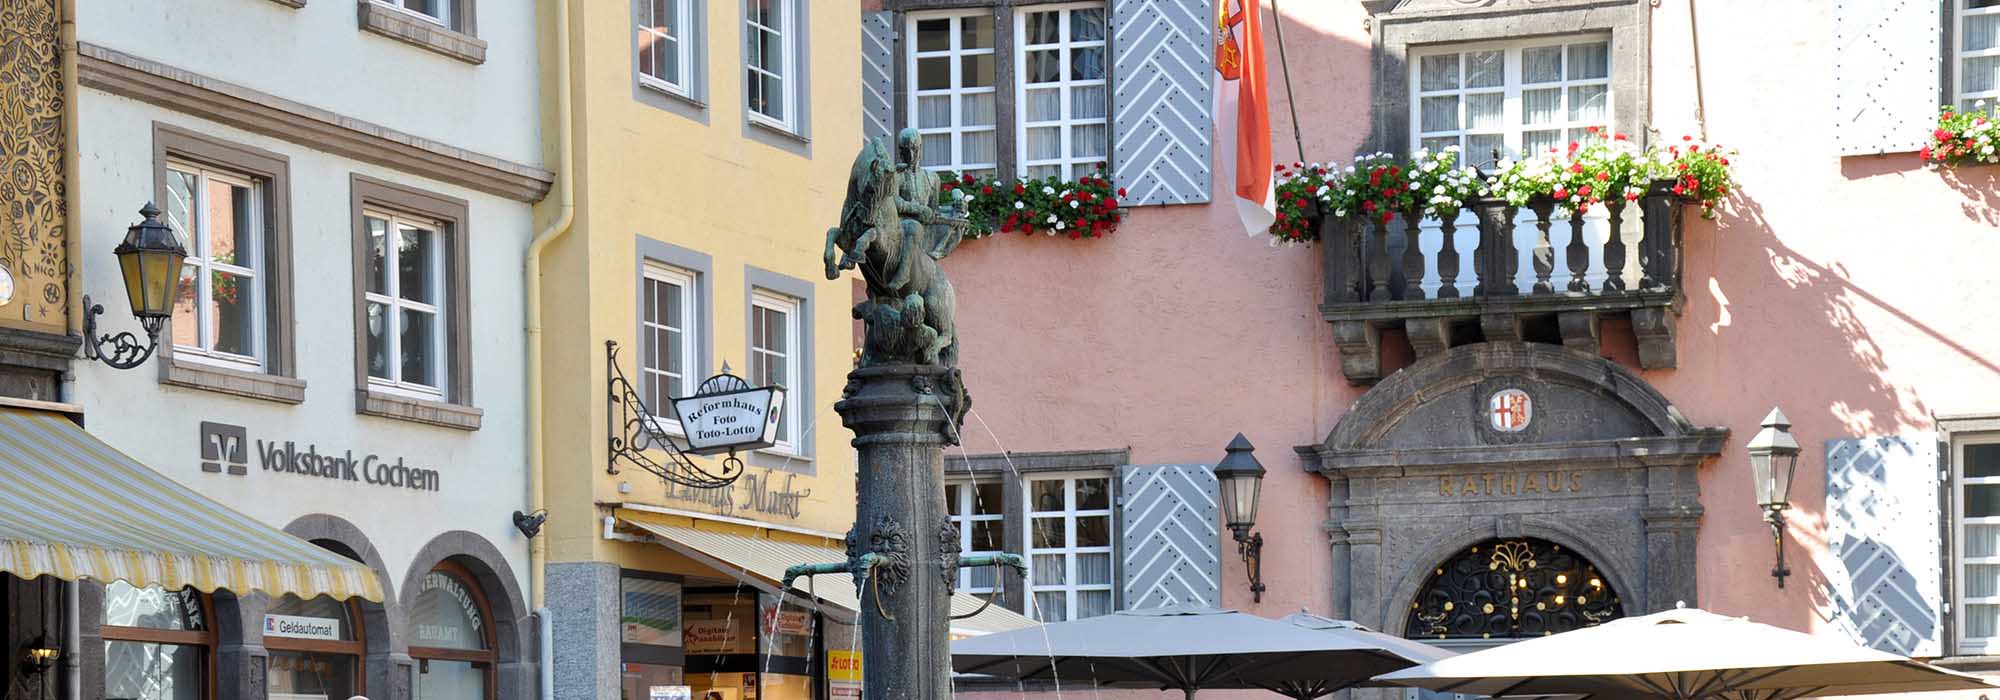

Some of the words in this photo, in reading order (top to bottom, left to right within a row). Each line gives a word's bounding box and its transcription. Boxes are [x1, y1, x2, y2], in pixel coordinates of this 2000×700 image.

[688, 397, 763, 424] Reformhaus
[713, 414, 737, 426] Foto
[695, 425, 756, 440] Toto-Lotto
[257, 439, 360, 482] Volksbank
[363, 454, 440, 492] Cochem
[739, 467, 811, 519] Markt
[1438, 471, 1584, 497] RATHAUS
[279, 620, 333, 637] Geldautomat
[839, 658, 860, 671] LOTO
